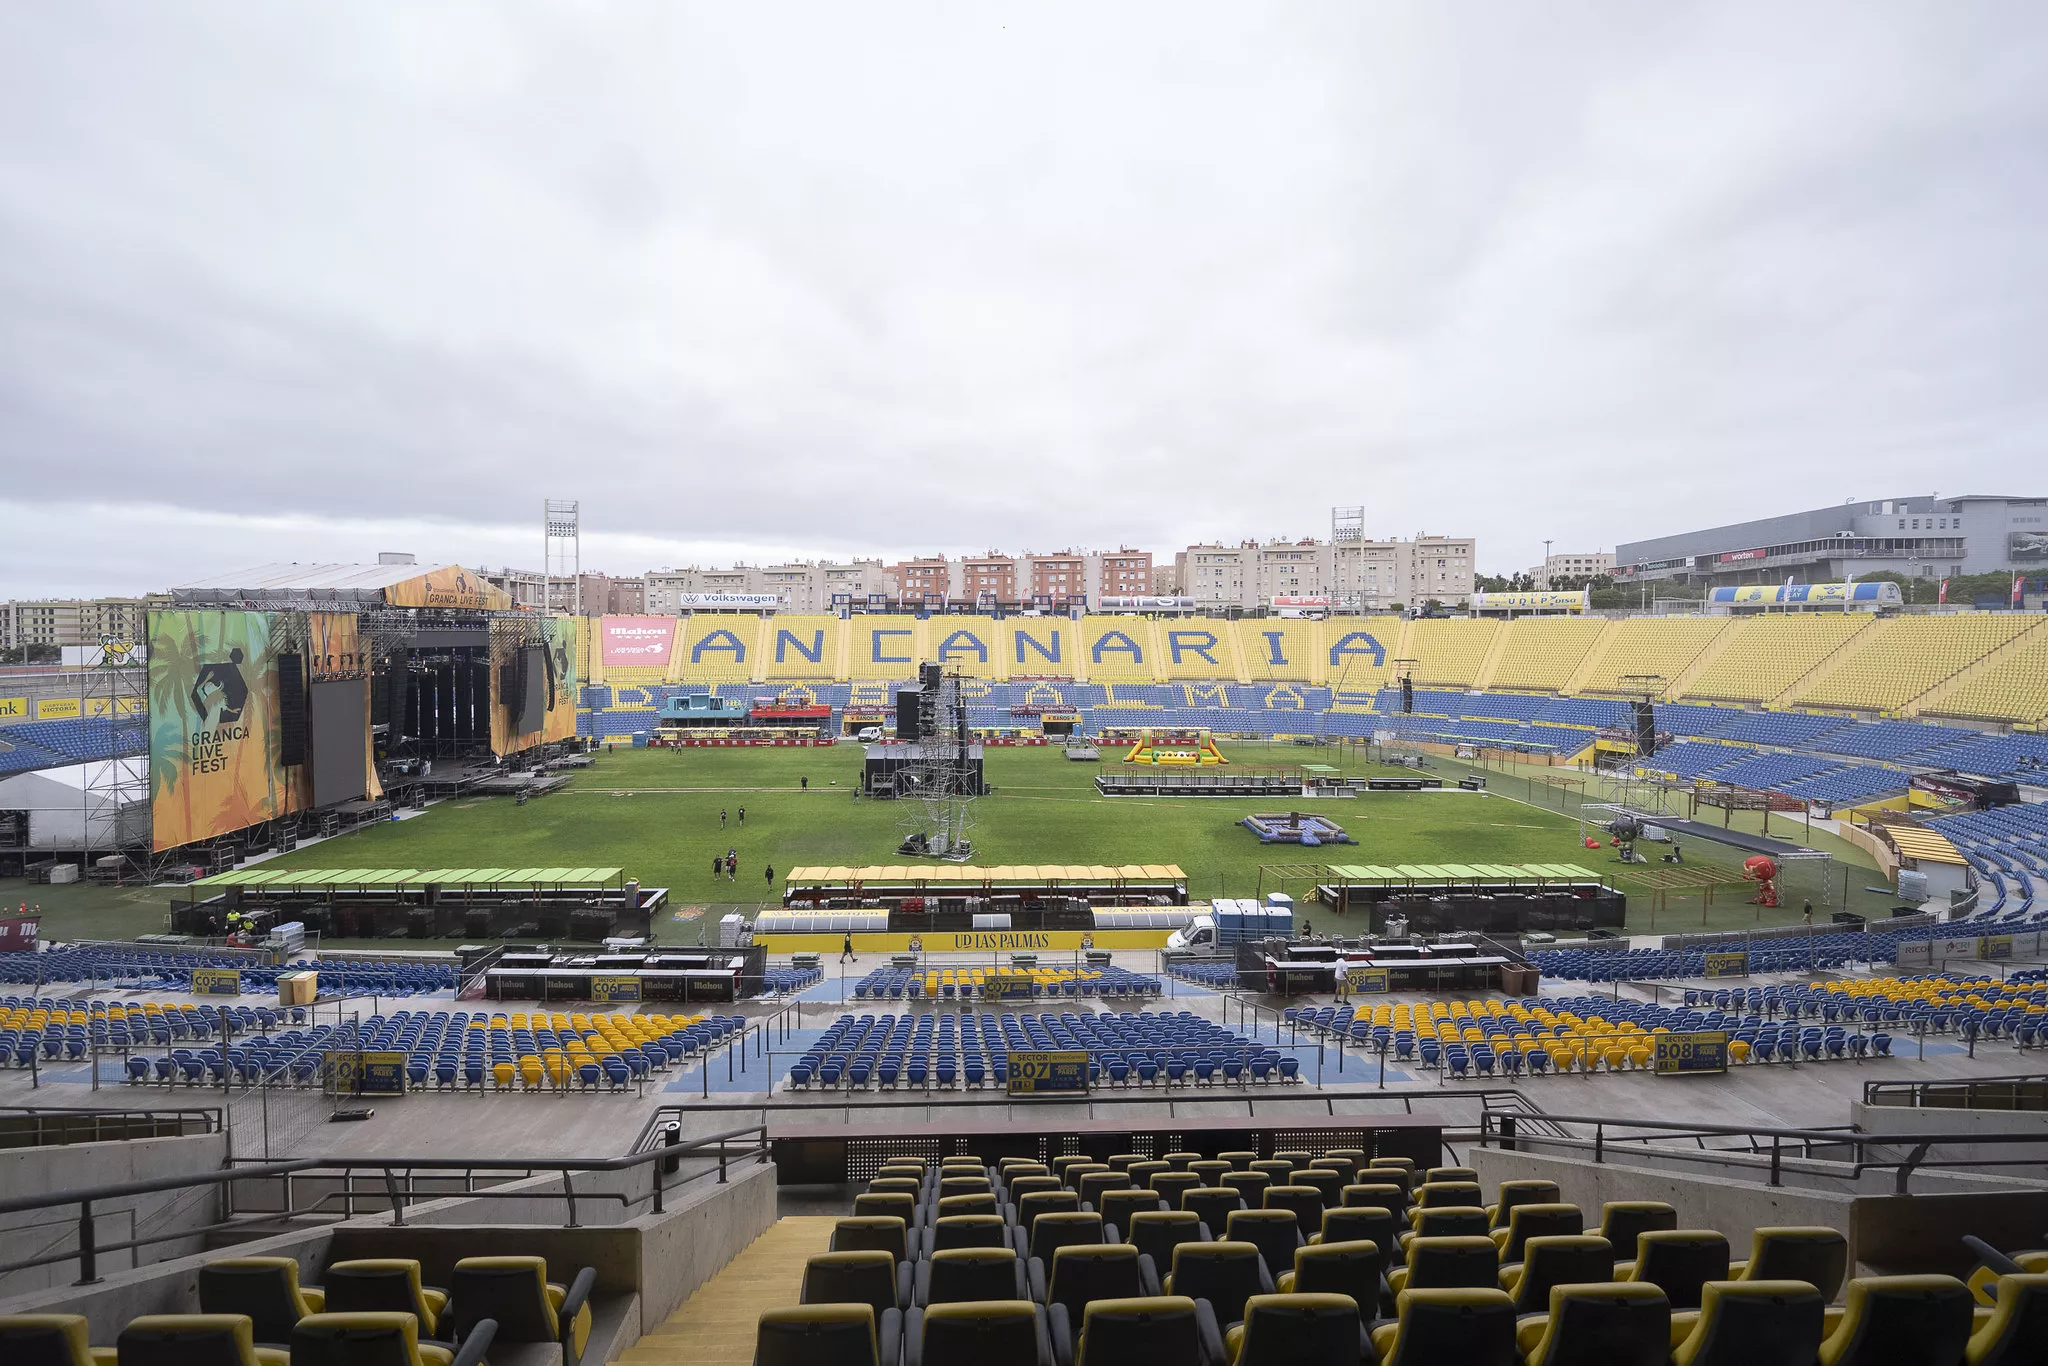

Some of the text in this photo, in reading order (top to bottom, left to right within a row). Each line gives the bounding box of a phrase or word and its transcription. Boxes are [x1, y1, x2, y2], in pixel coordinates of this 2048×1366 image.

[1731, 552, 1754, 561] worten
[429, 594, 489, 606] GRANCA LIVE FEST
[703, 594, 776, 604] Volkswagen
[610, 627, 667, 635] Mahou
[192, 726, 250, 746] GRANCA
[192, 743, 223, 761] LIVE
[192, 756, 228, 776] FEST
[1912, 776, 1937, 790] Mahou
[790, 910, 879, 918] Volkswagen
[955, 933, 1049, 948] UD LAS PALMAS
[1707, 959, 1726, 969] C09
[195, 976, 217, 987] C05
[694, 981, 723, 990] Mahou
[594, 983, 618, 993] C06
[1657, 1042, 1691, 1059] B08
[1009, 1062, 1049, 1078] B07
